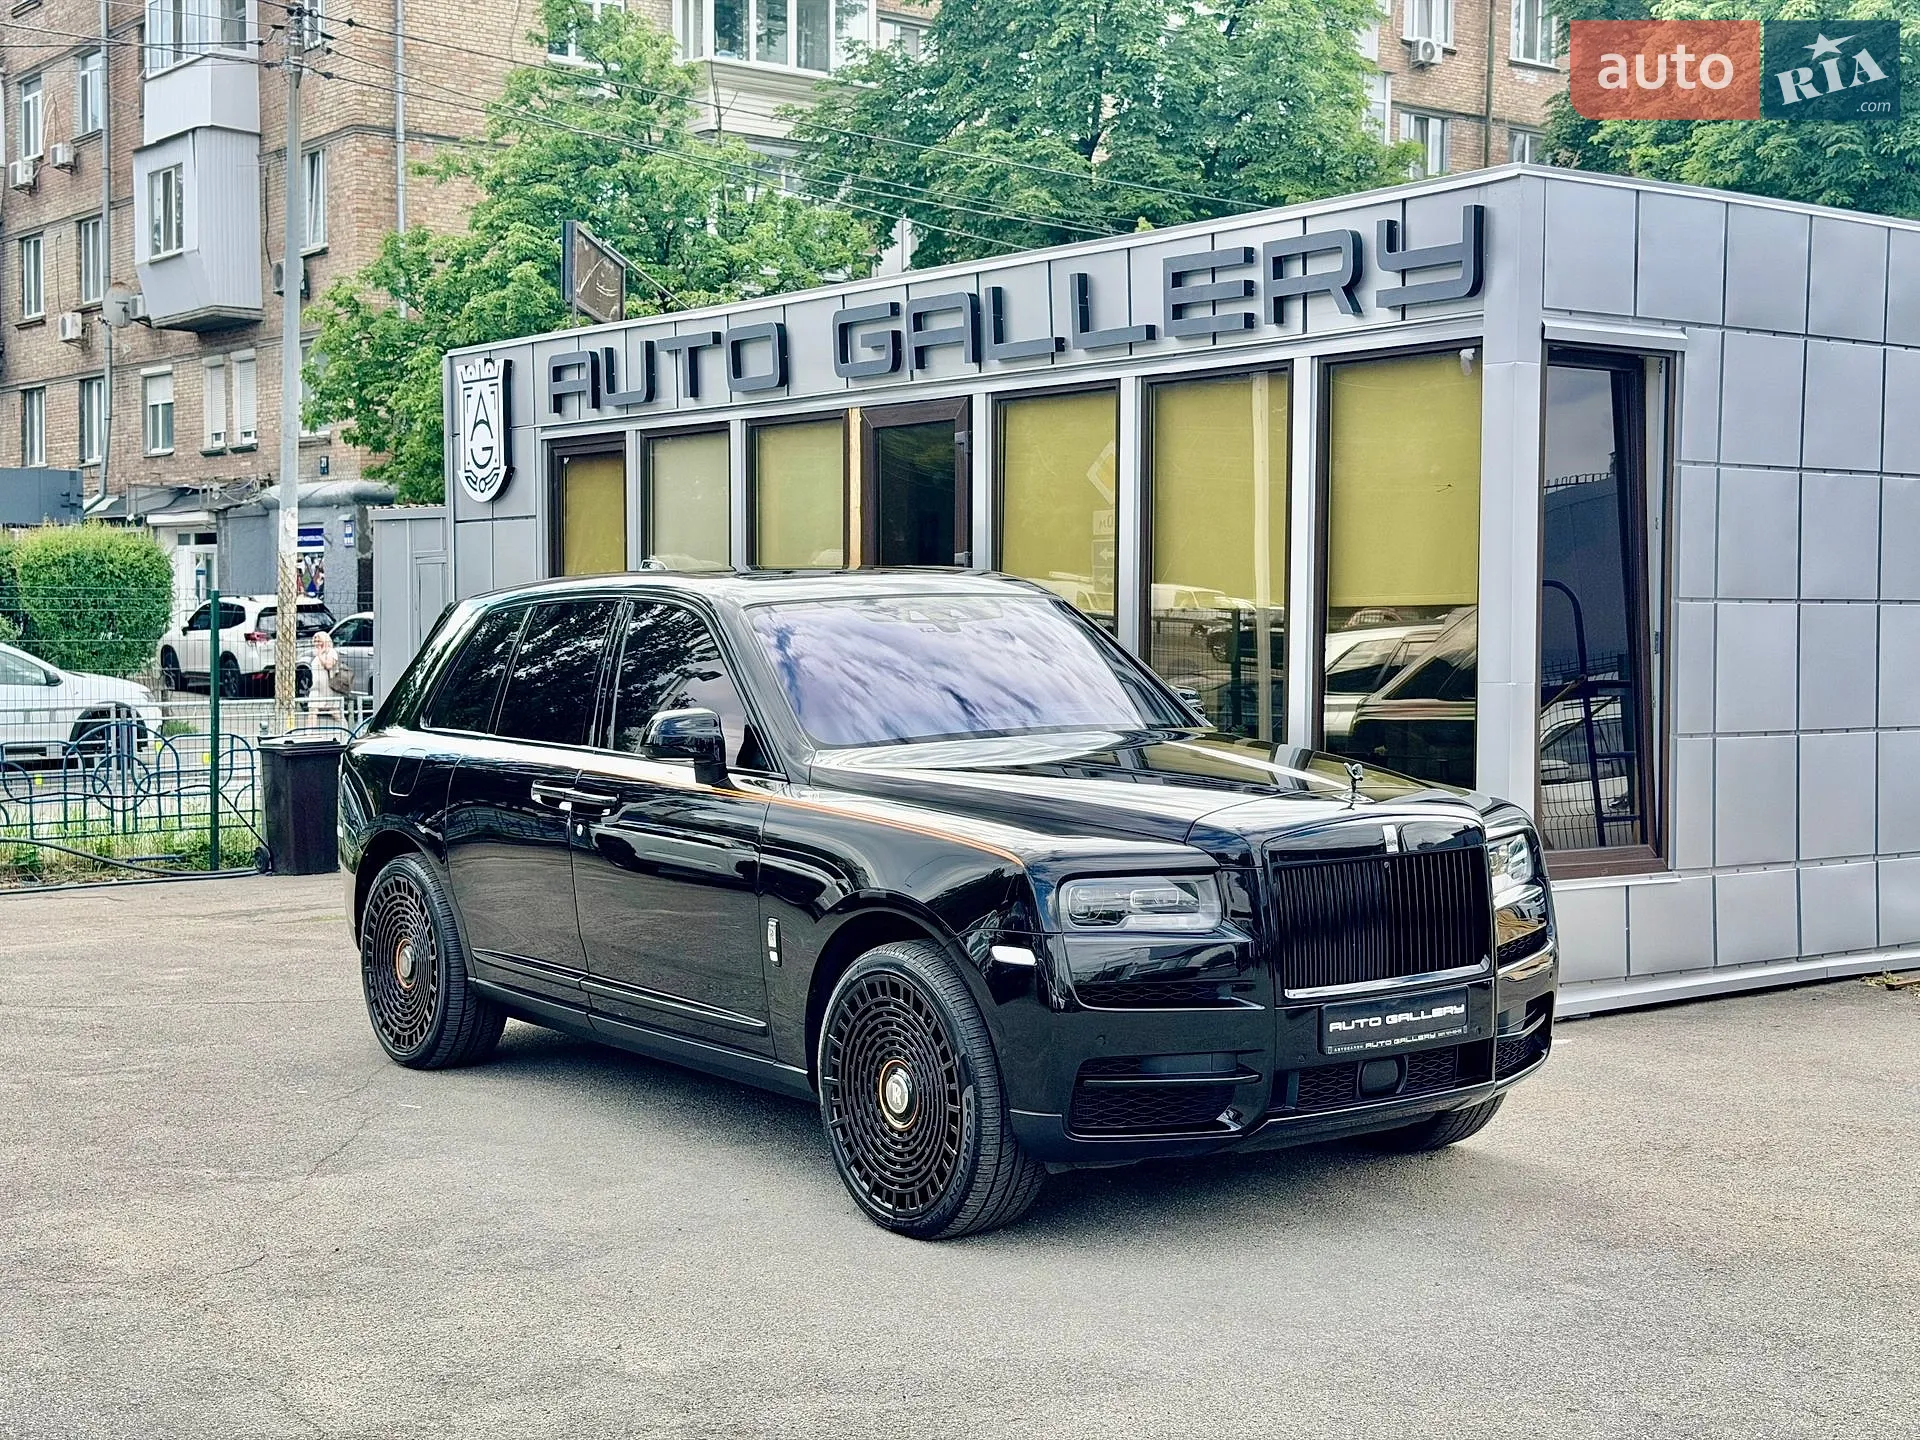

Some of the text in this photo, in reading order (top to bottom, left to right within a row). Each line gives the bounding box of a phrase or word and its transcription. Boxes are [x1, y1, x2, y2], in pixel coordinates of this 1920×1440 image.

[548, 204, 1484, 414] AUTO GALLERY
[1329, 1004, 1465, 1033] AUTO GALLERY
[1365, 1040, 1392, 1049] AUTO
[1393, 1032, 1436, 1045] GALLERY
